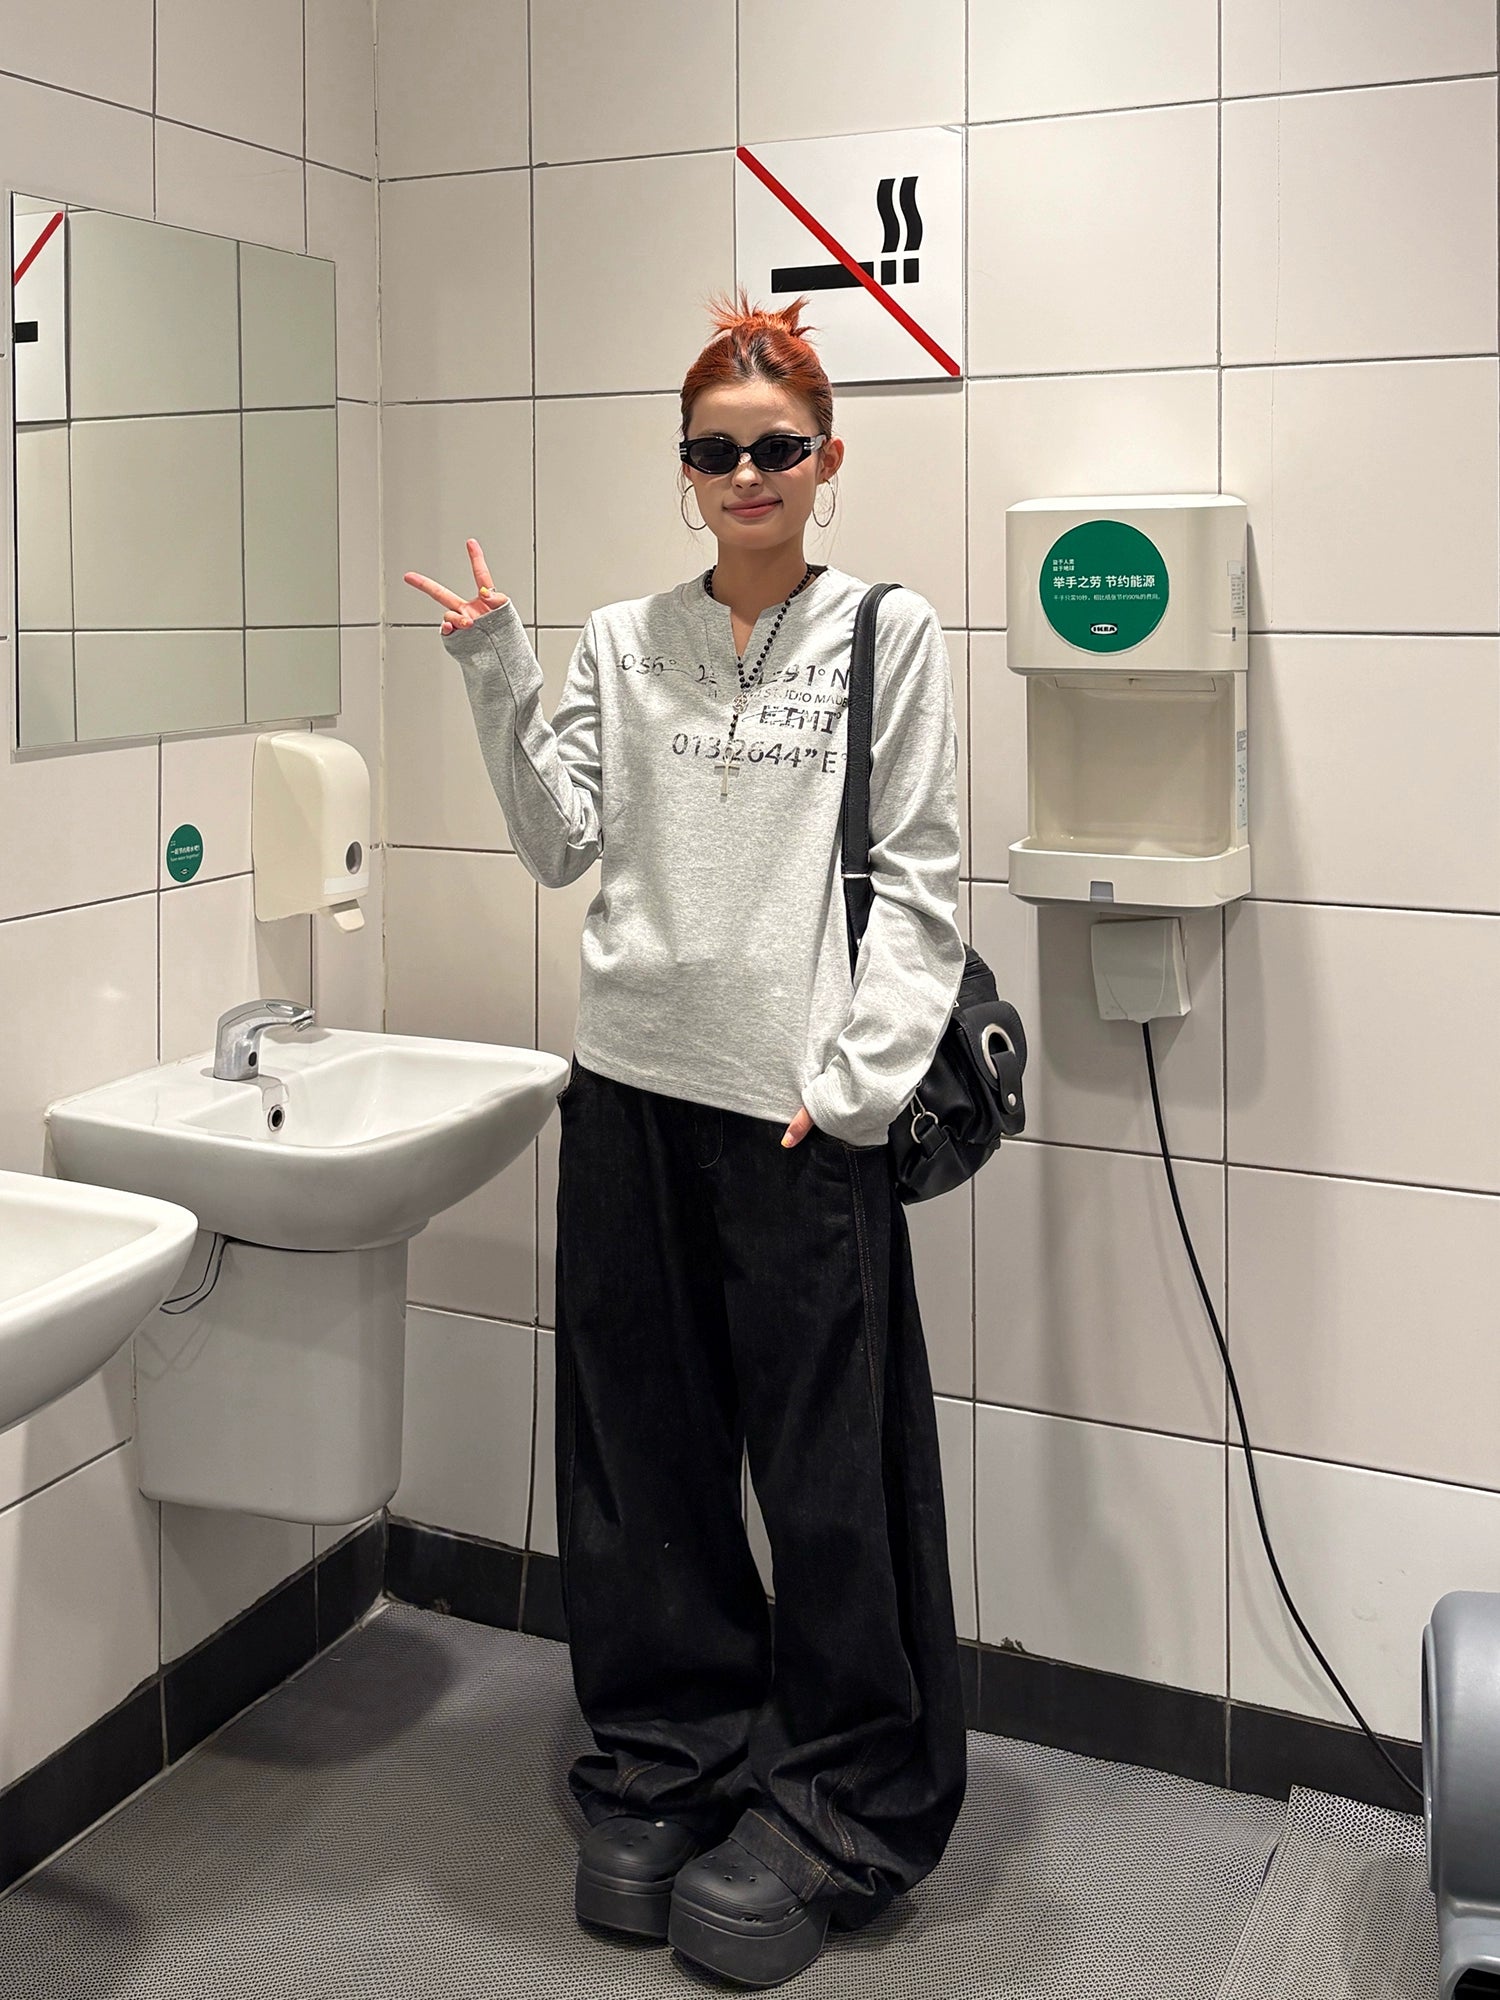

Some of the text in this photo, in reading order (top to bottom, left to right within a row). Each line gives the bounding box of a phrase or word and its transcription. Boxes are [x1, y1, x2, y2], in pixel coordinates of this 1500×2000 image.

[1053, 575, 1156, 589] 举手之劳 节约能源
